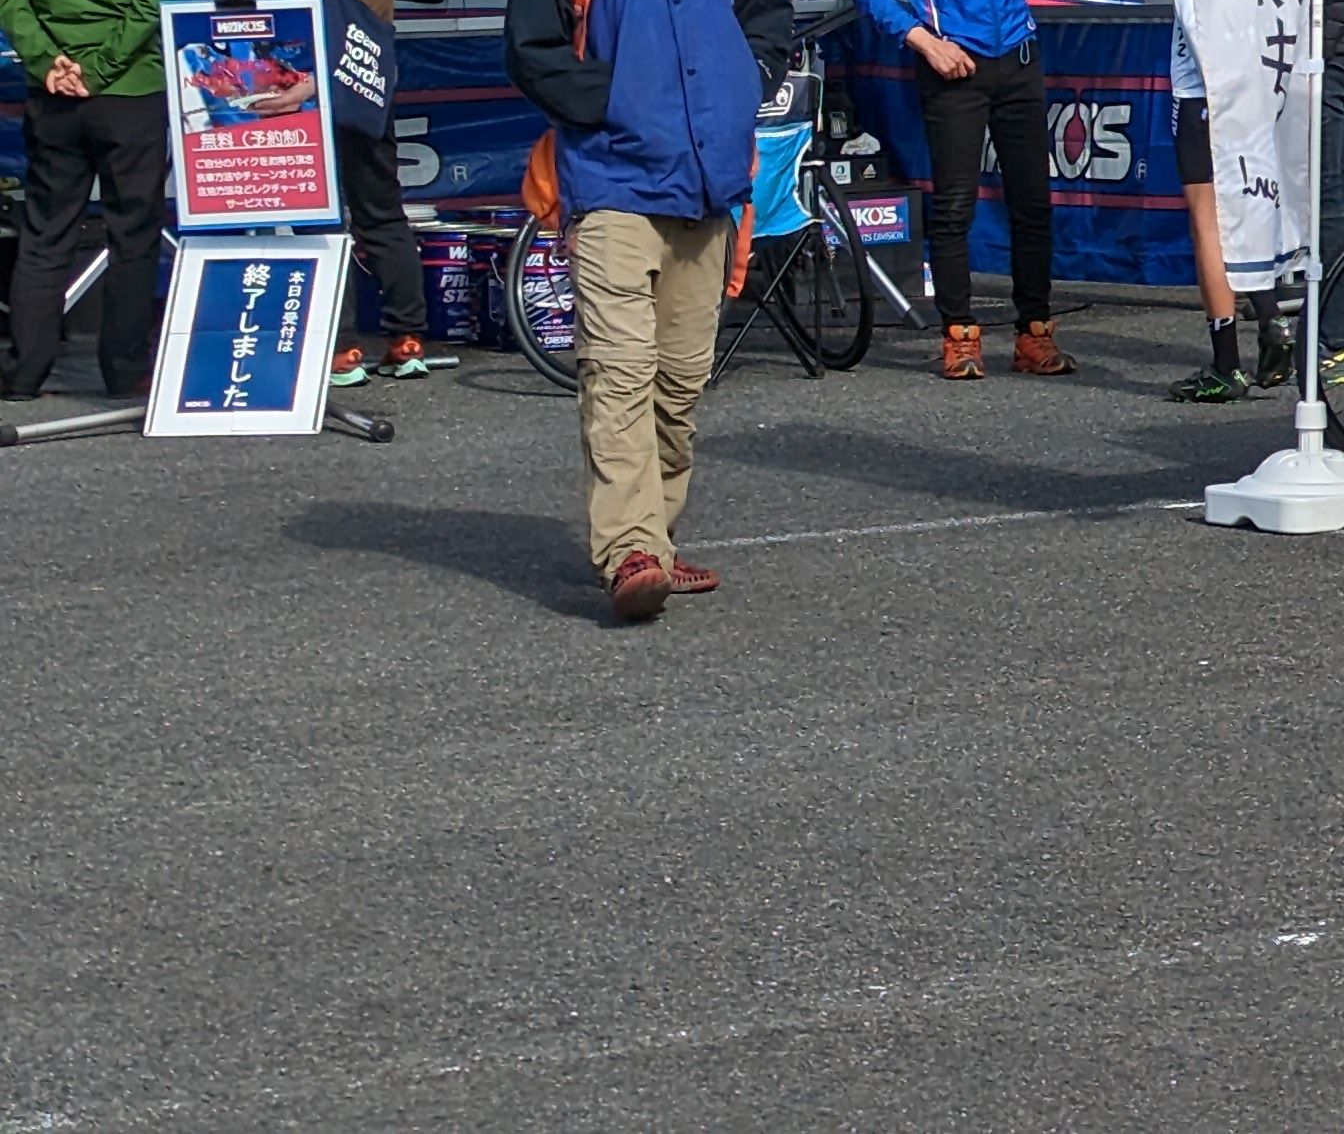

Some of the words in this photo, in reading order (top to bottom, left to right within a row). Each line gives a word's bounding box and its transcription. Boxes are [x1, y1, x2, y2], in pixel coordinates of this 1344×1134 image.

[346, 23, 382, 57] team
[223, 264, 271, 408] 終了しました
[277, 271, 305, 353] 本日の受付は
